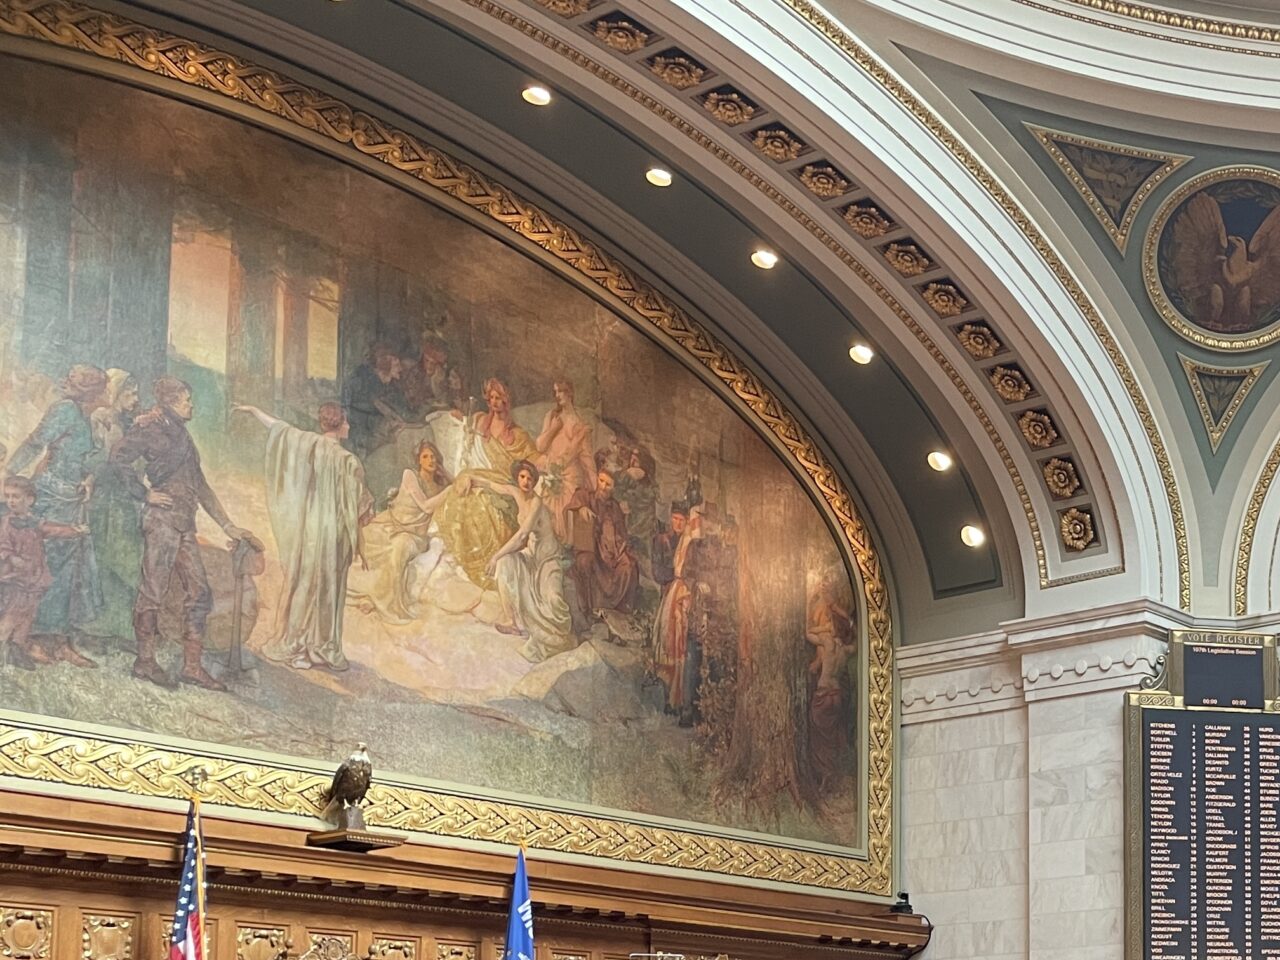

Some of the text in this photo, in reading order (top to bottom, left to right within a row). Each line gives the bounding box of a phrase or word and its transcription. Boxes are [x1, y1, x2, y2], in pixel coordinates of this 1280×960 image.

[1187, 633, 1260, 645] VOTE REGISTER
[1208, 647, 1235, 655] Legislative
